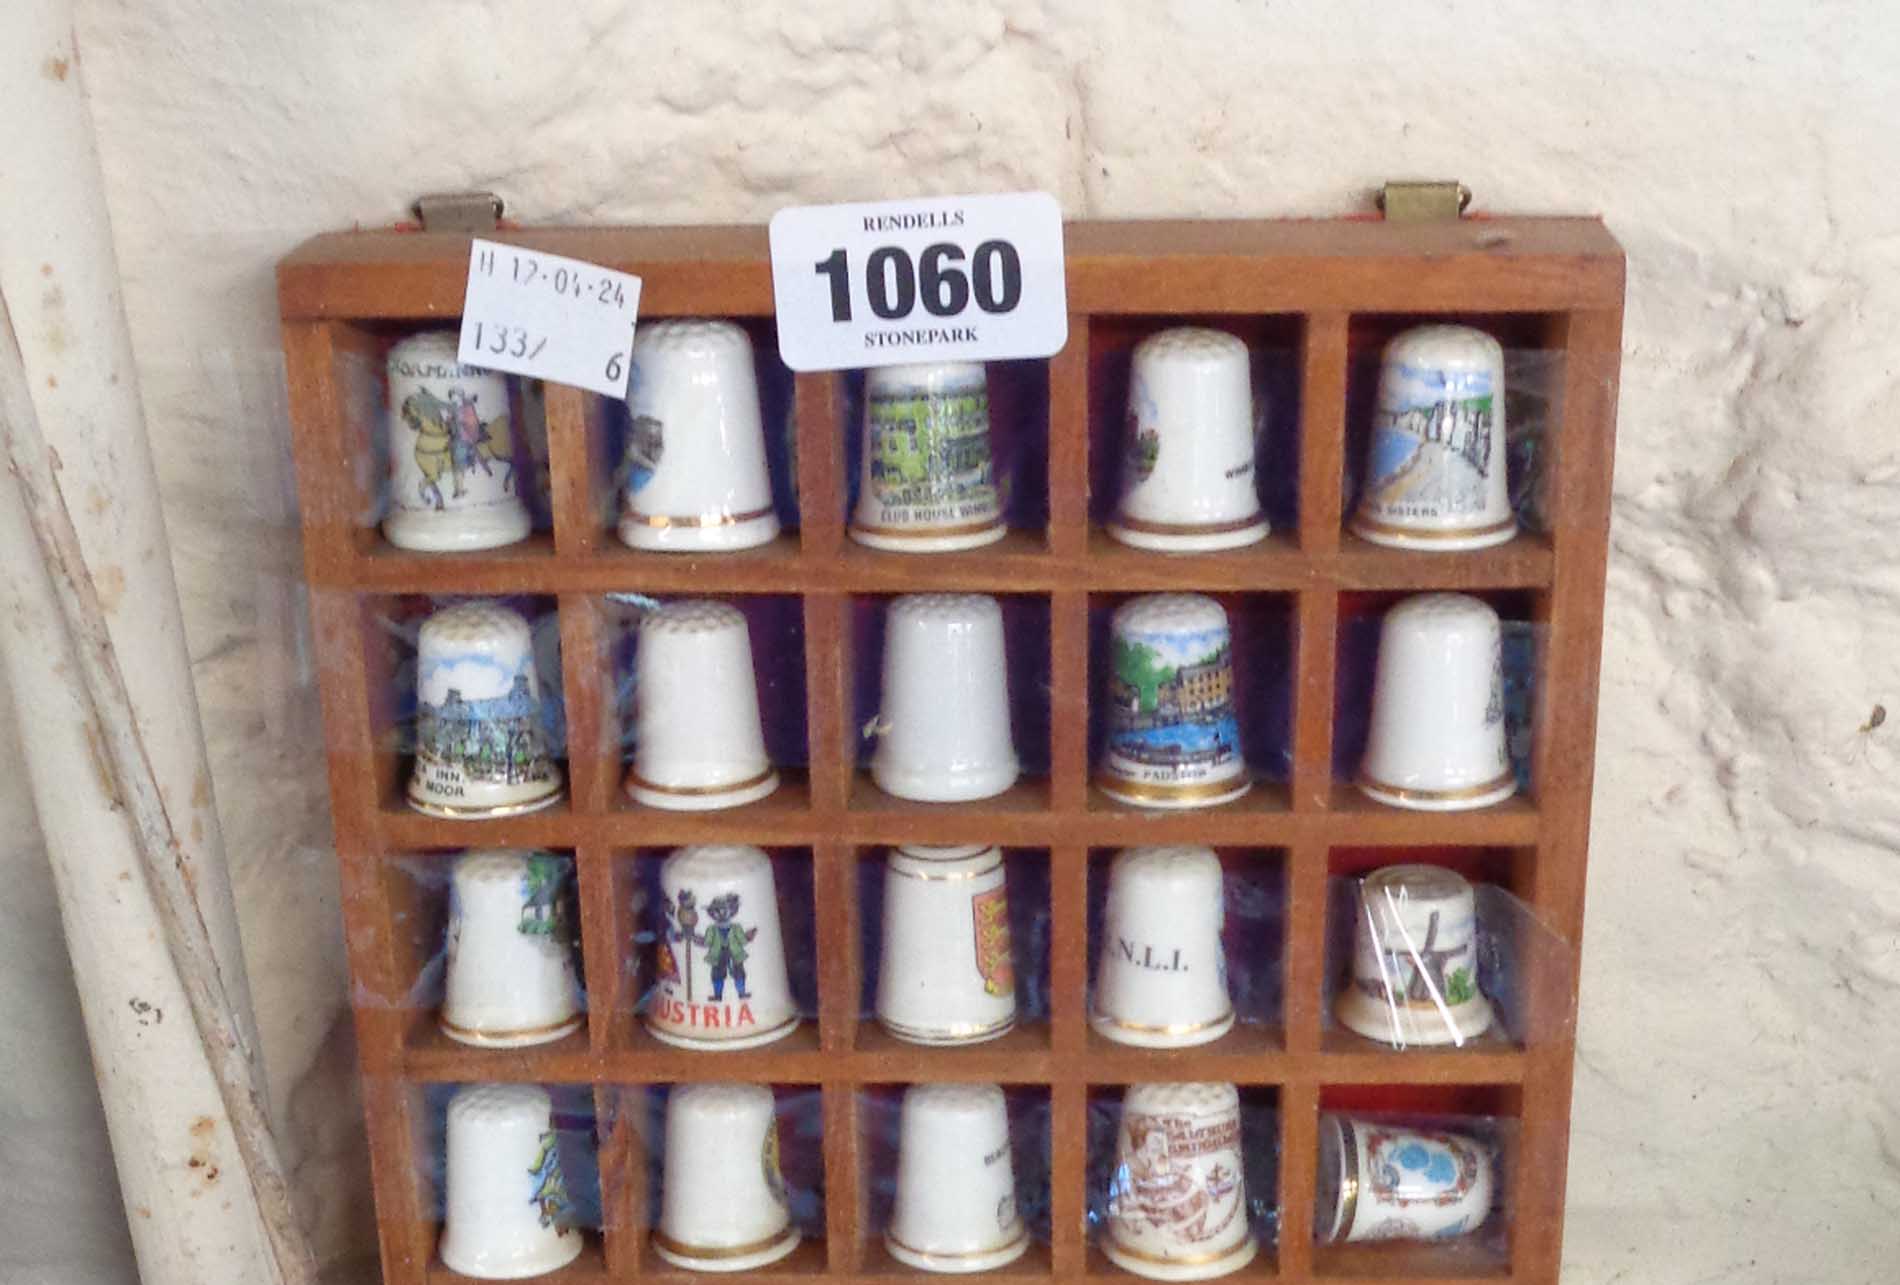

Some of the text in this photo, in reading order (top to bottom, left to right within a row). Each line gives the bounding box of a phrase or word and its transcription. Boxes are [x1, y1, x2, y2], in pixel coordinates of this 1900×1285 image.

[863, 210, 965, 232] RENDELLS
[814, 238, 1022, 323] 1060
[864, 326, 979, 349] STONEPARK
[604, 352, 624, 382] 6
[435, 769, 461, 785] INN
[426, 782, 465, 798] MOOR
